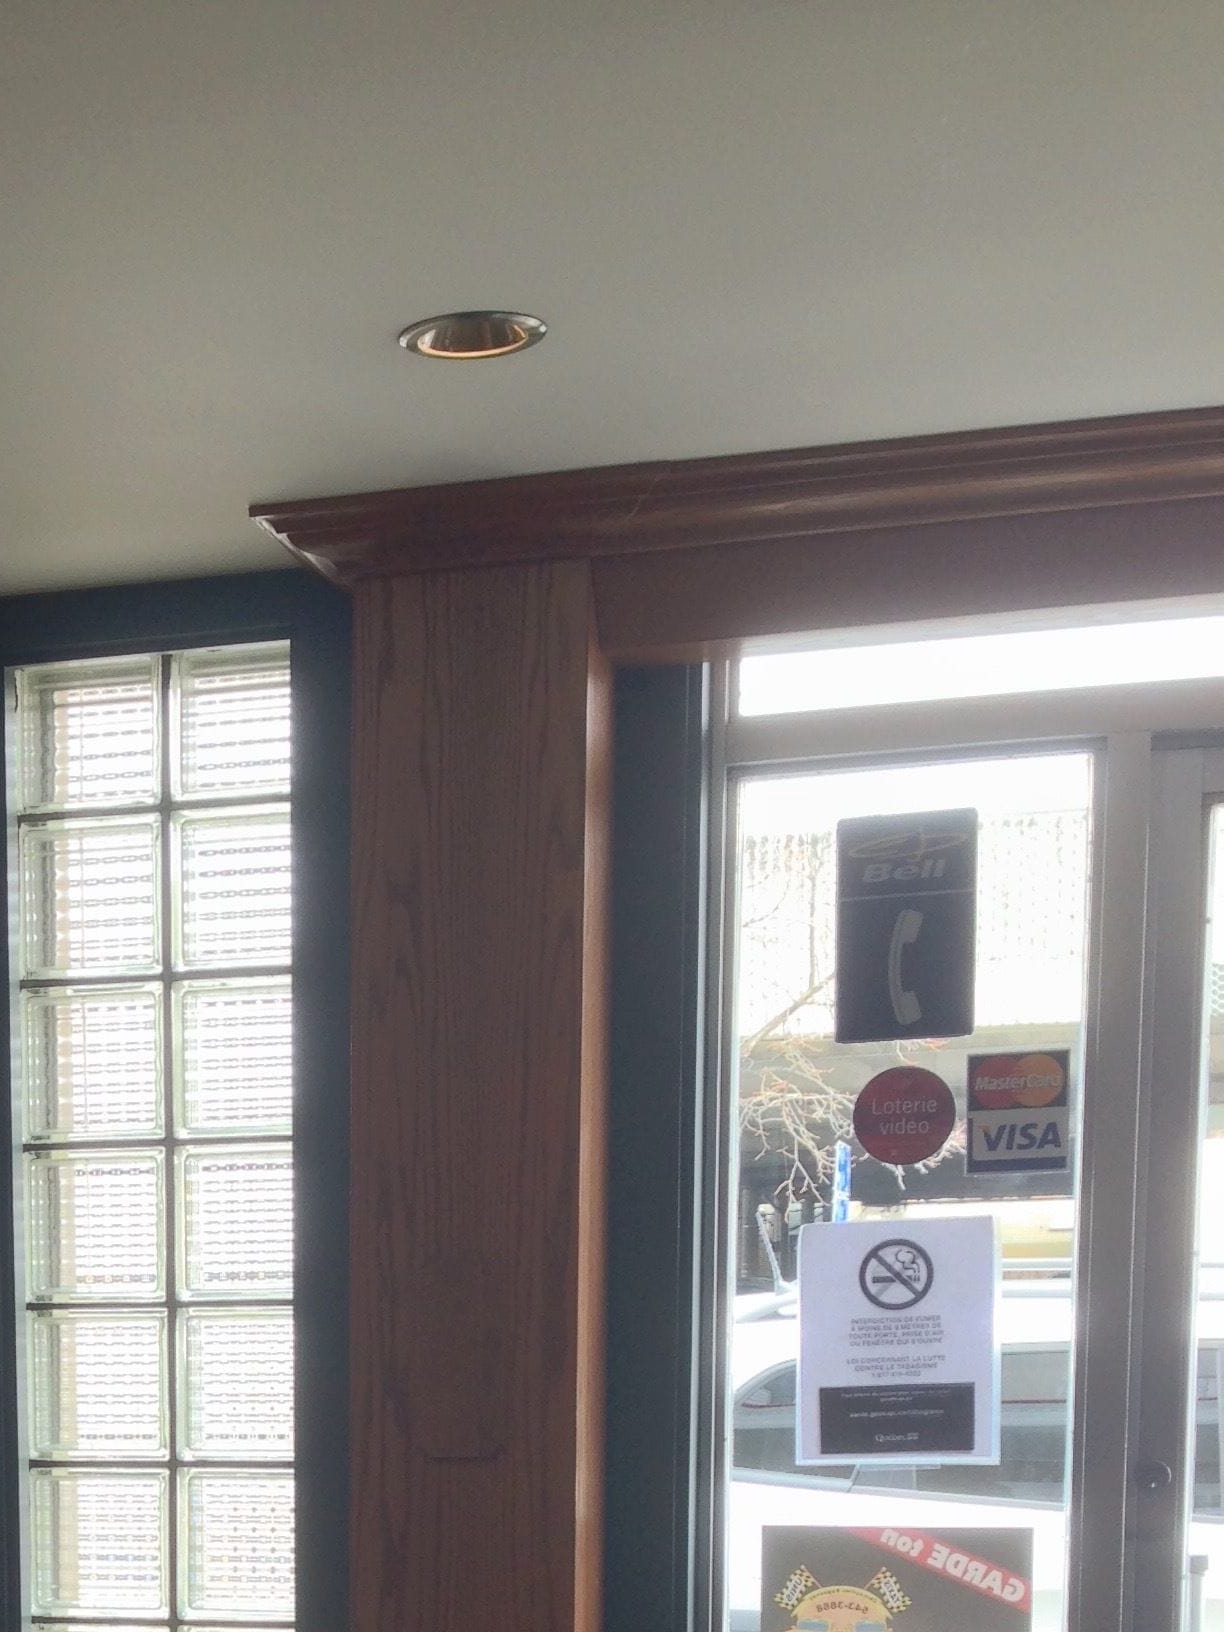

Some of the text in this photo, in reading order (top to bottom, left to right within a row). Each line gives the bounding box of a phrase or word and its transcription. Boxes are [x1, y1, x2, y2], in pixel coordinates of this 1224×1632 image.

[862, 858, 946, 882] Bell
[975, 1073, 1062, 1091] MasterCard
[872, 1097, 937, 1116] Loterie
[981, 1121, 1062, 1151] VISA
